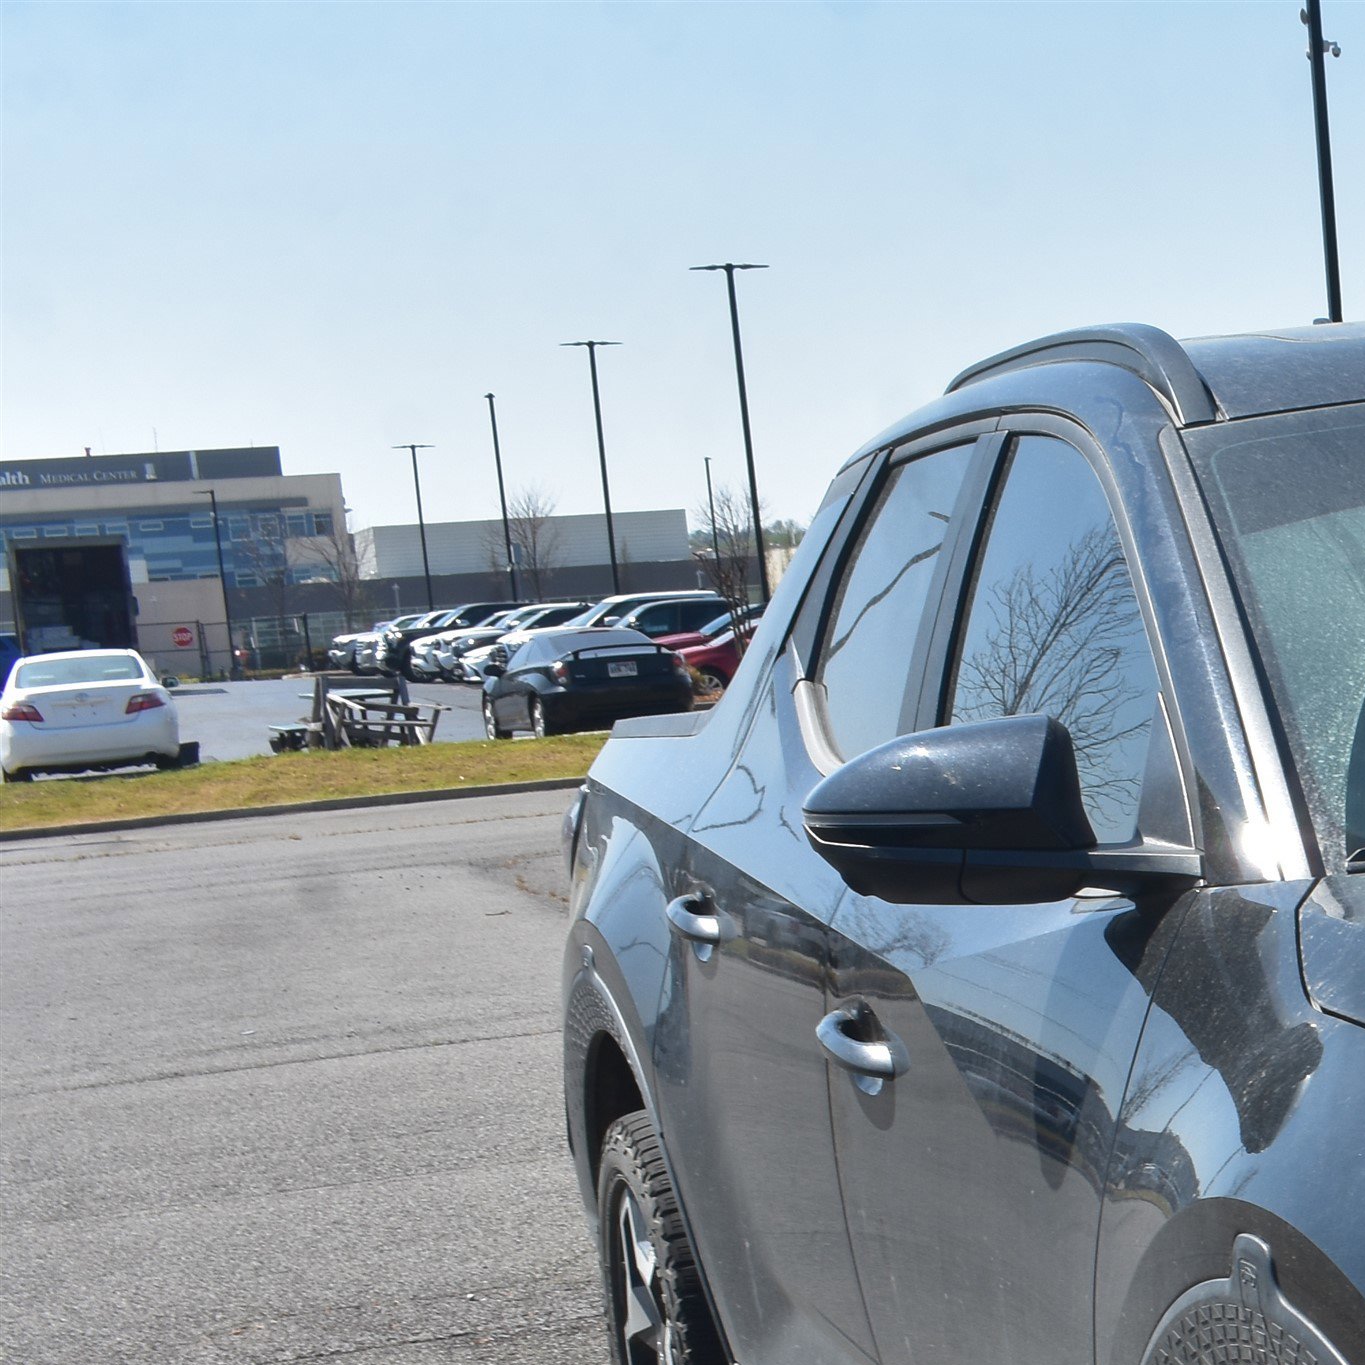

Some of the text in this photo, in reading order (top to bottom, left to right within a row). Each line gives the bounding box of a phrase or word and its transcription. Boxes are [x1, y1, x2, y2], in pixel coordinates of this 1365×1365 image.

[40, 473, 90, 484] MEDICAL
[93, 470, 138, 481] CENTER
[172, 631, 193, 642] STOP
